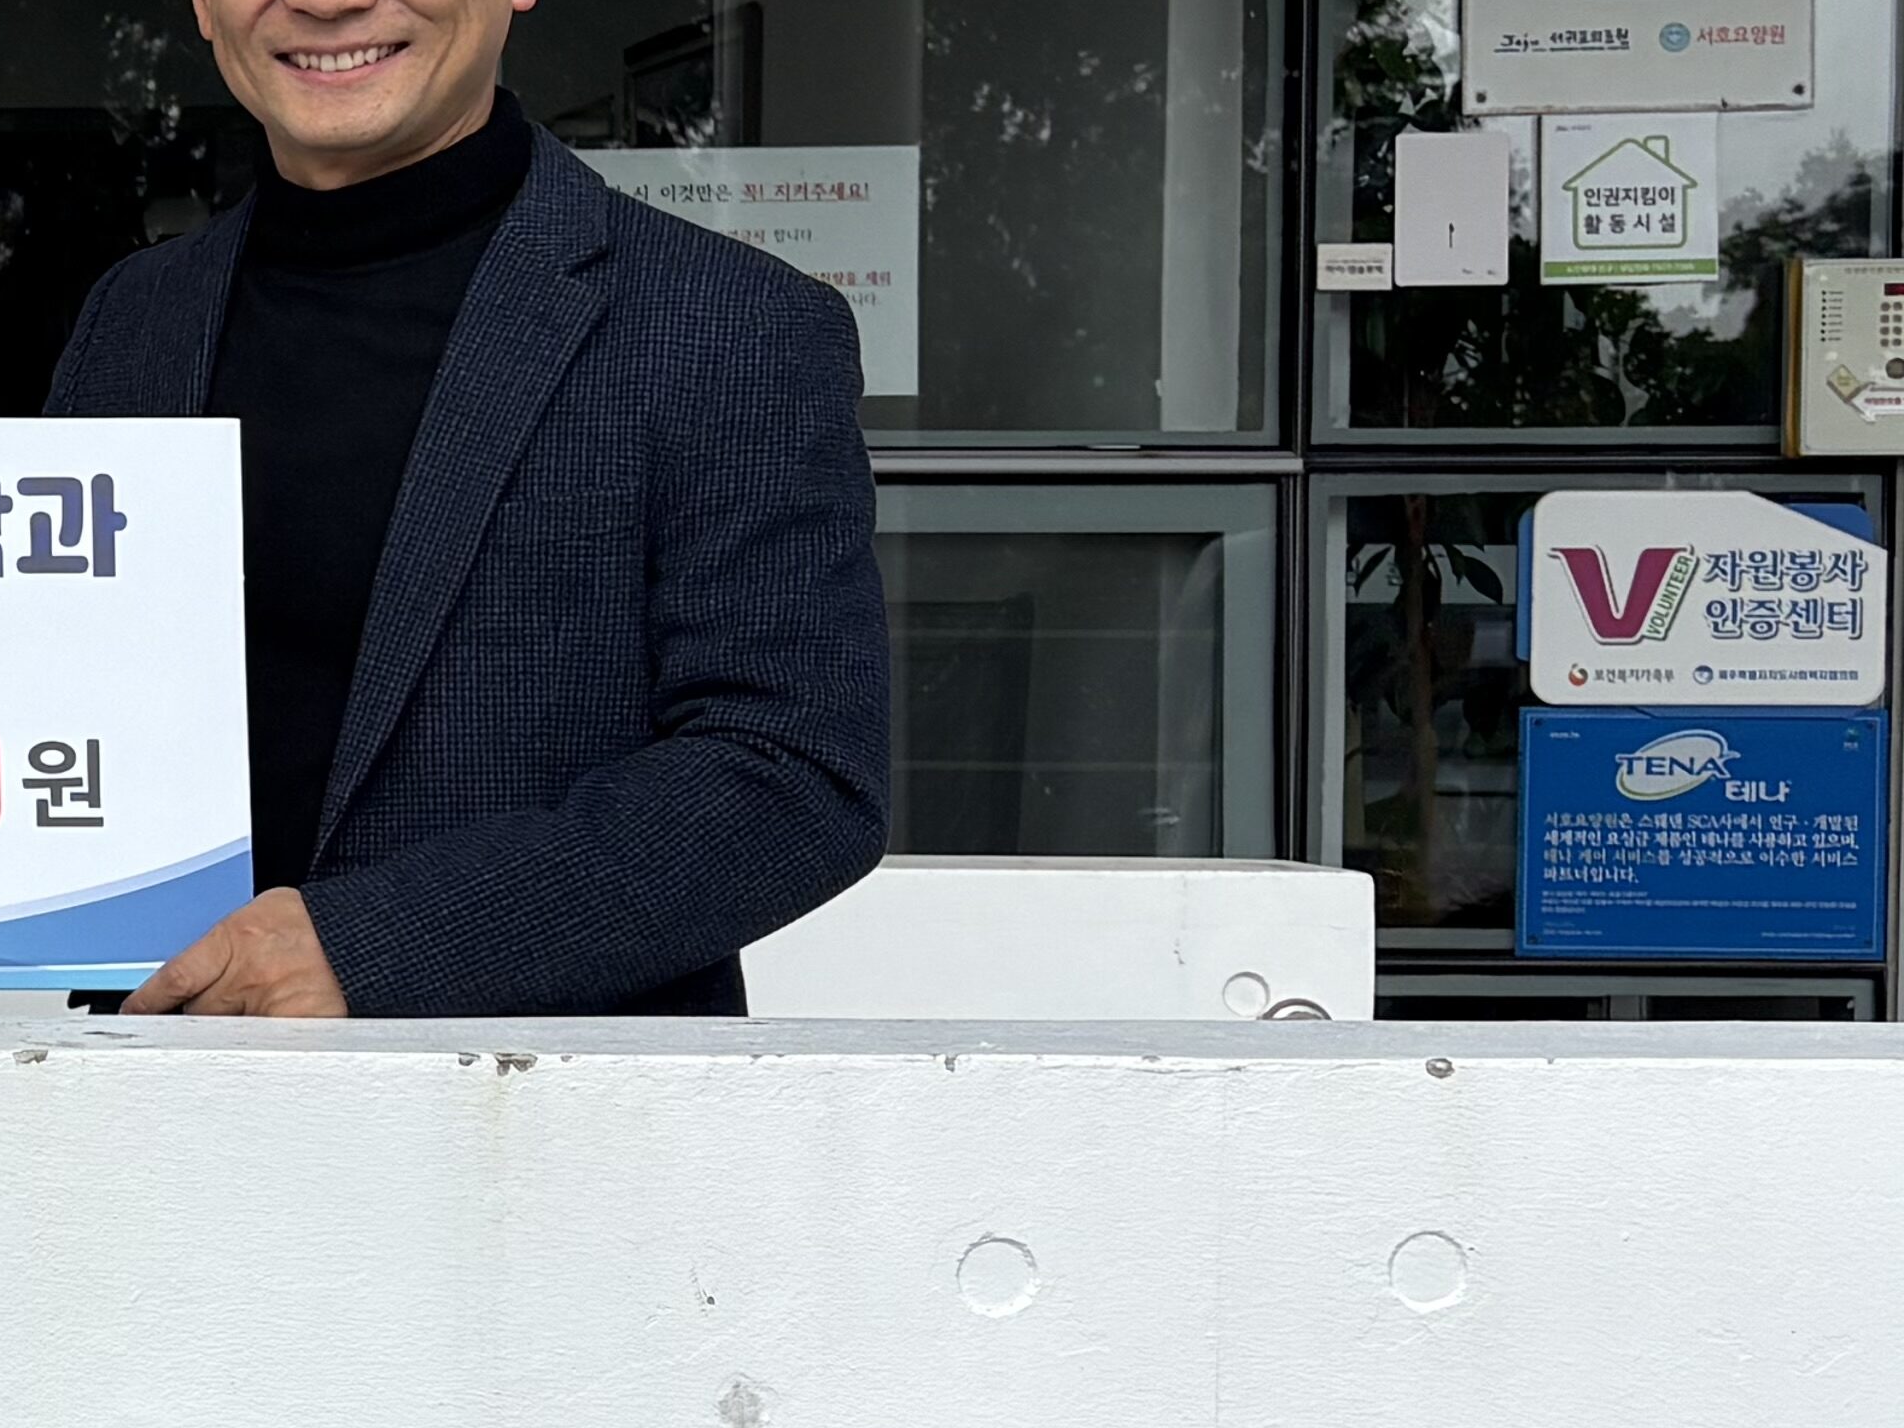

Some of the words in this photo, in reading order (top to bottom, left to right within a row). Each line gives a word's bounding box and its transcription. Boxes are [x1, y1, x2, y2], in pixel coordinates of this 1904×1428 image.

[1695, 24, 1786, 47] 서호요양원
[659, 183, 733, 204] 이것만은
[1583, 186, 1676, 208] 인권지킴이
[1704, 549, 1867, 592] 자원봉사
[1644, 554, 1692, 639] VOLUNTEER
[1703, 597, 1865, 640] 인증센터
[1616, 754, 1732, 779] TENA
[21, 738, 105, 828] 원
[1724, 780, 1792, 803] 테나
